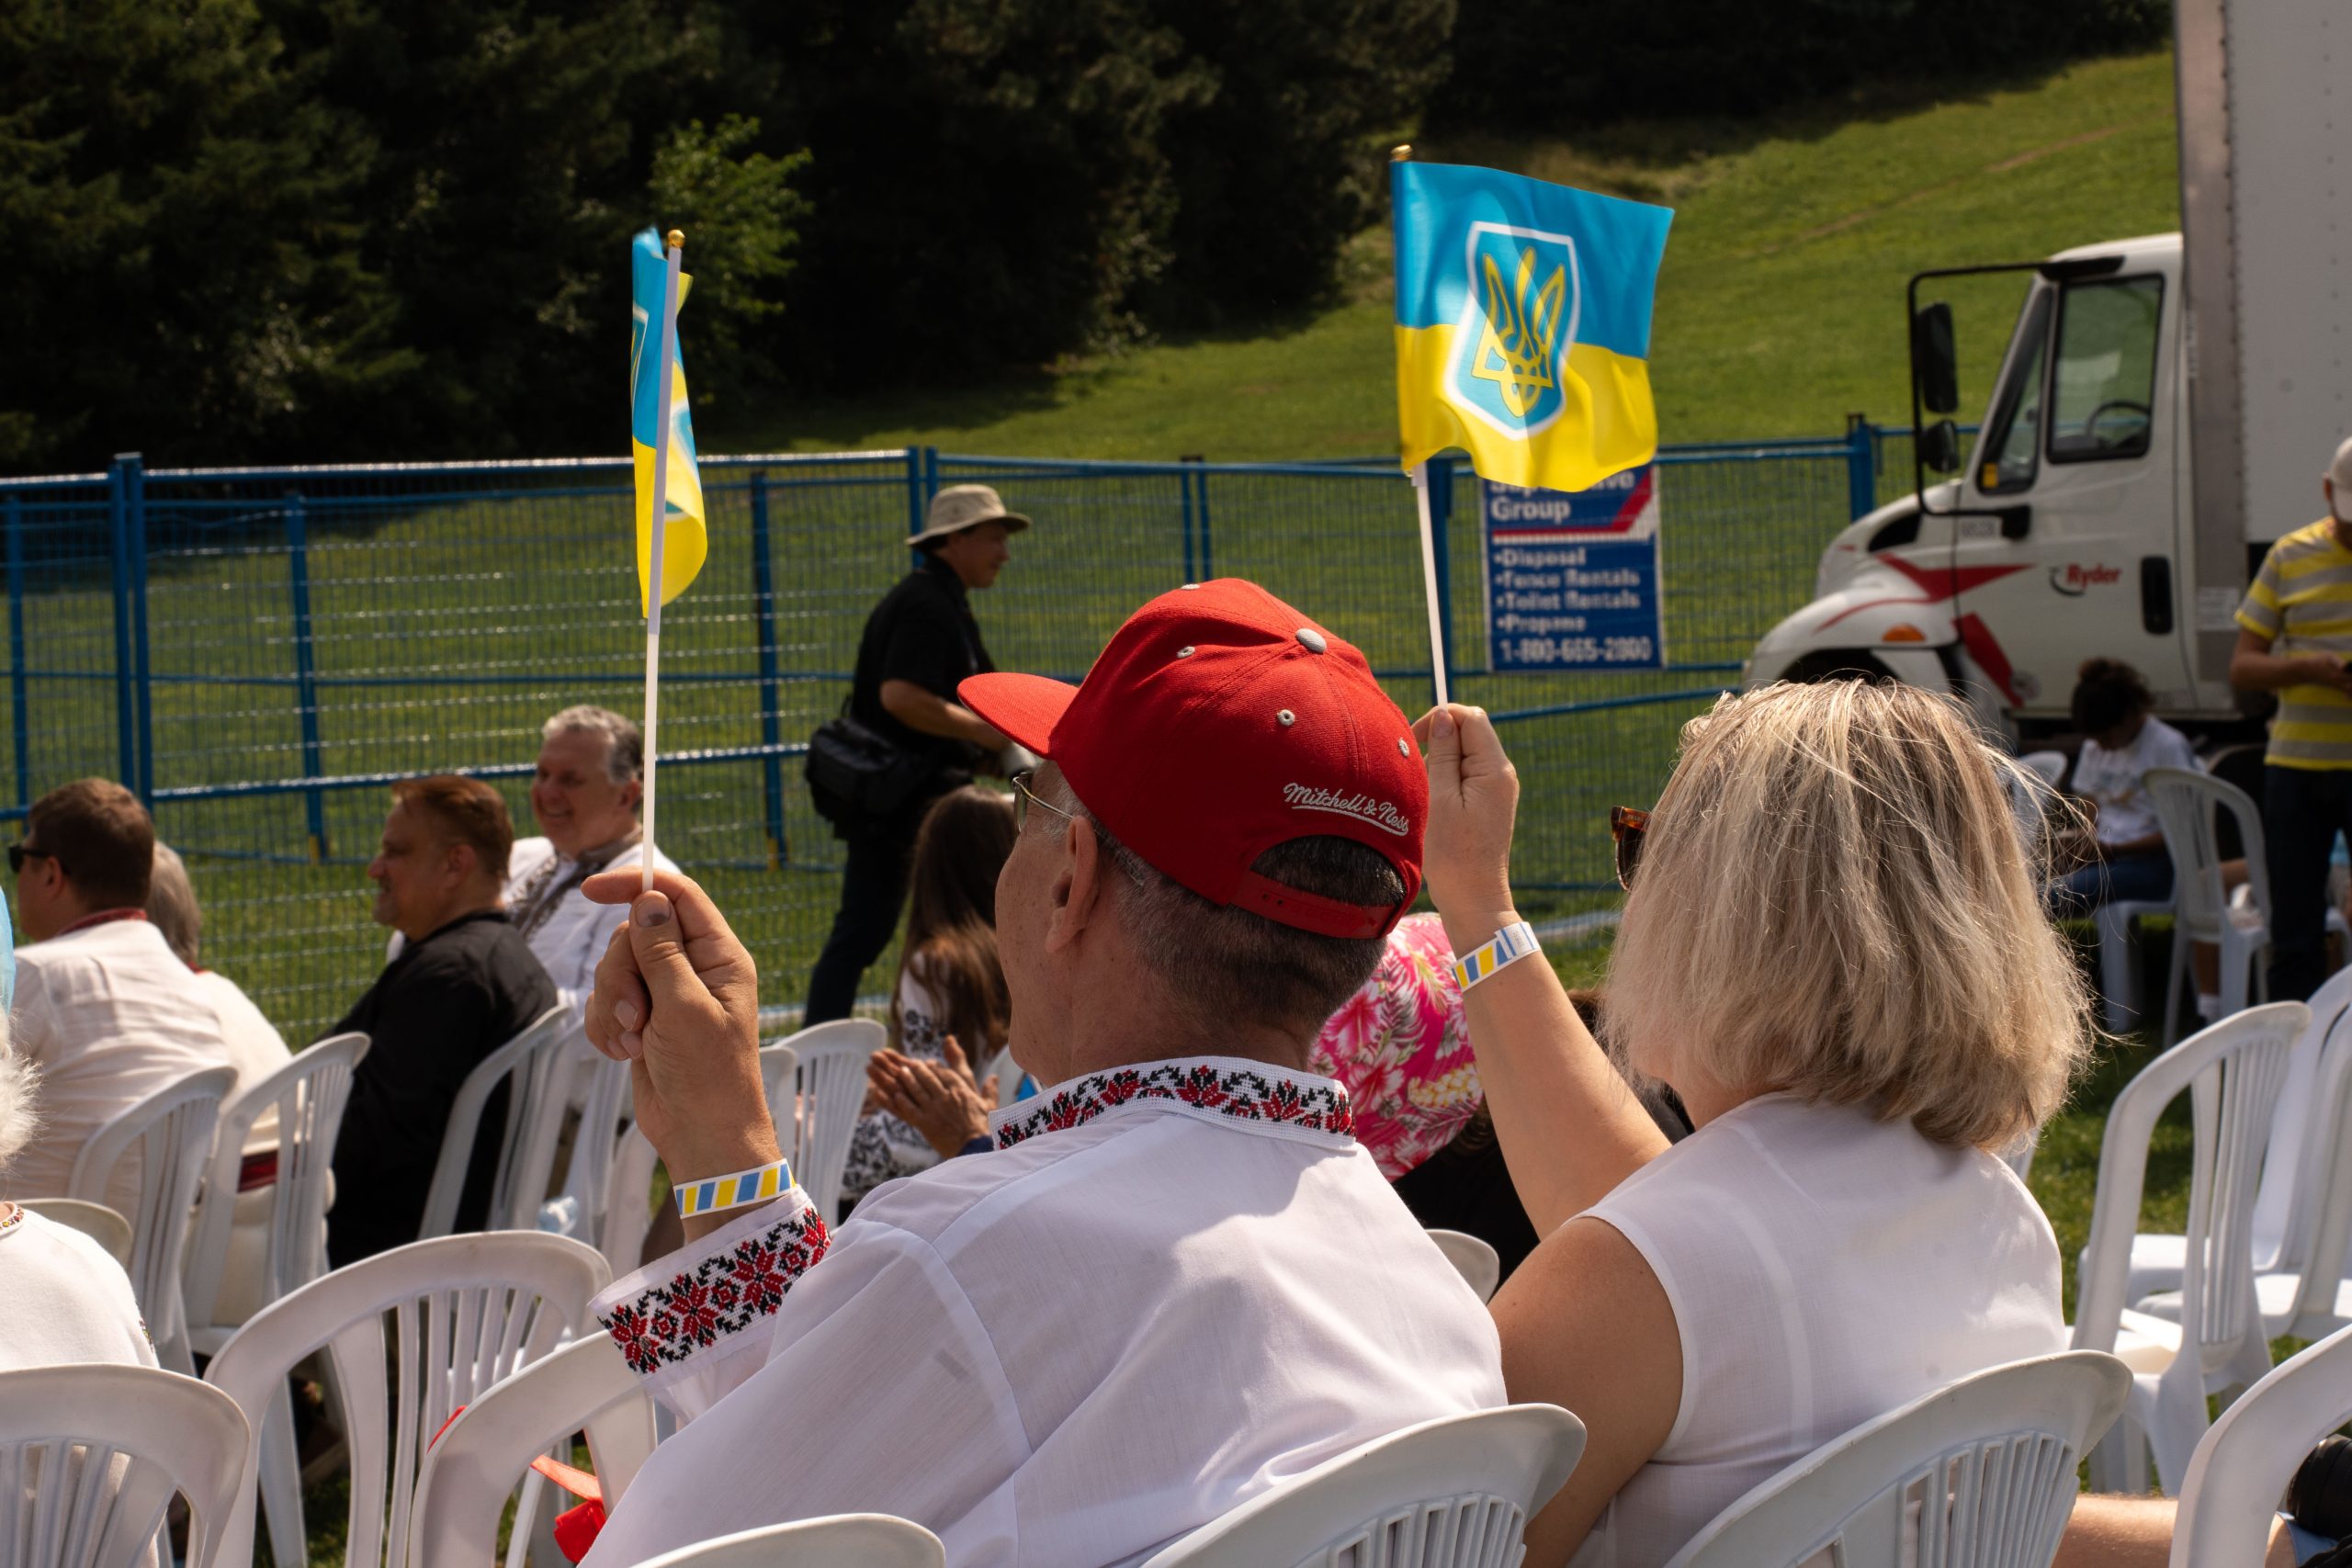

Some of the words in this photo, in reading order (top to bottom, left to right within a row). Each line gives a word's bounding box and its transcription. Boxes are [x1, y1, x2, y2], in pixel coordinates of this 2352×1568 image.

[1490, 496, 1570, 525] Group
[2066, 562, 2122, 589] Ryder
[1283, 783, 1367, 811] Mitchell
[1363, 799, 1378, 816] &
[1378, 801, 1409, 833] Ness
